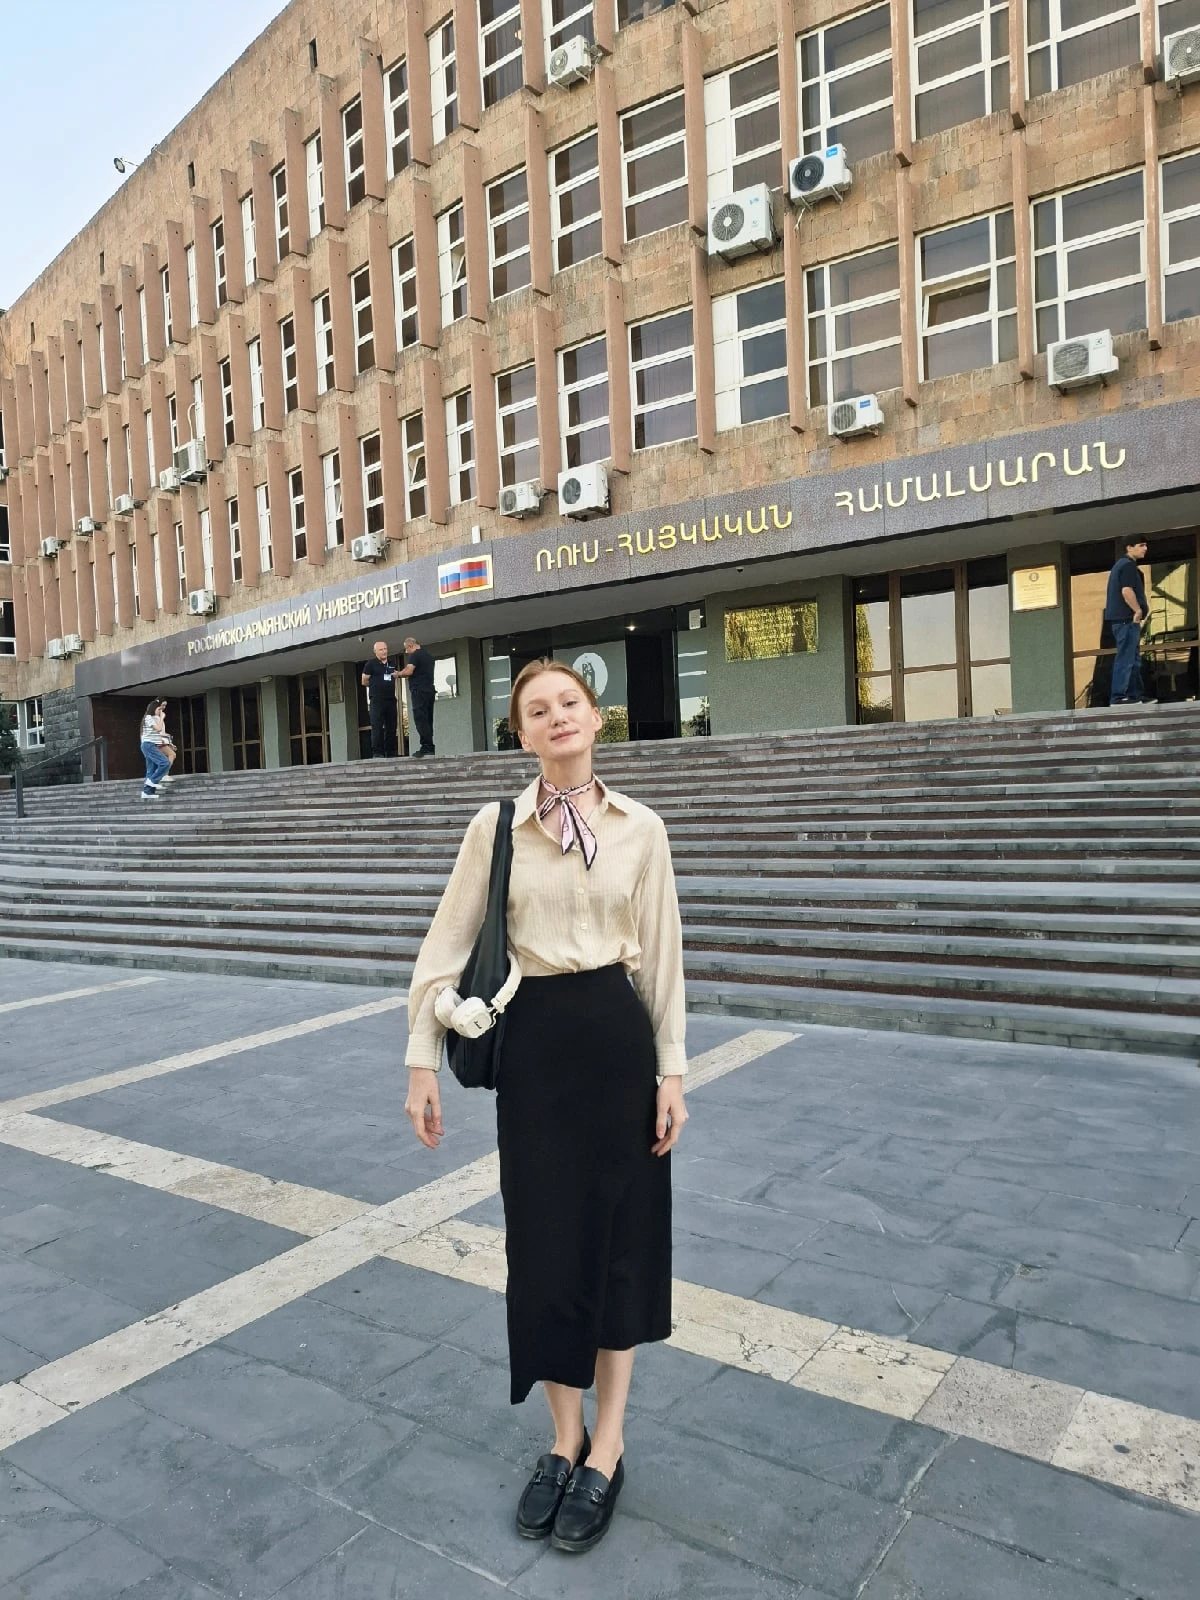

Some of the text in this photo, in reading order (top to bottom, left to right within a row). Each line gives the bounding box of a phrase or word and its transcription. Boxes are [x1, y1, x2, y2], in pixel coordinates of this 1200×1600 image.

[834, 441, 1127, 516] ՀԱՄԱԼՍԱՐԱՆ
[187, 579, 410, 657] РОССИЙСКО-АРМЯНСКИЙ УНИВЕРСИТЕТ
